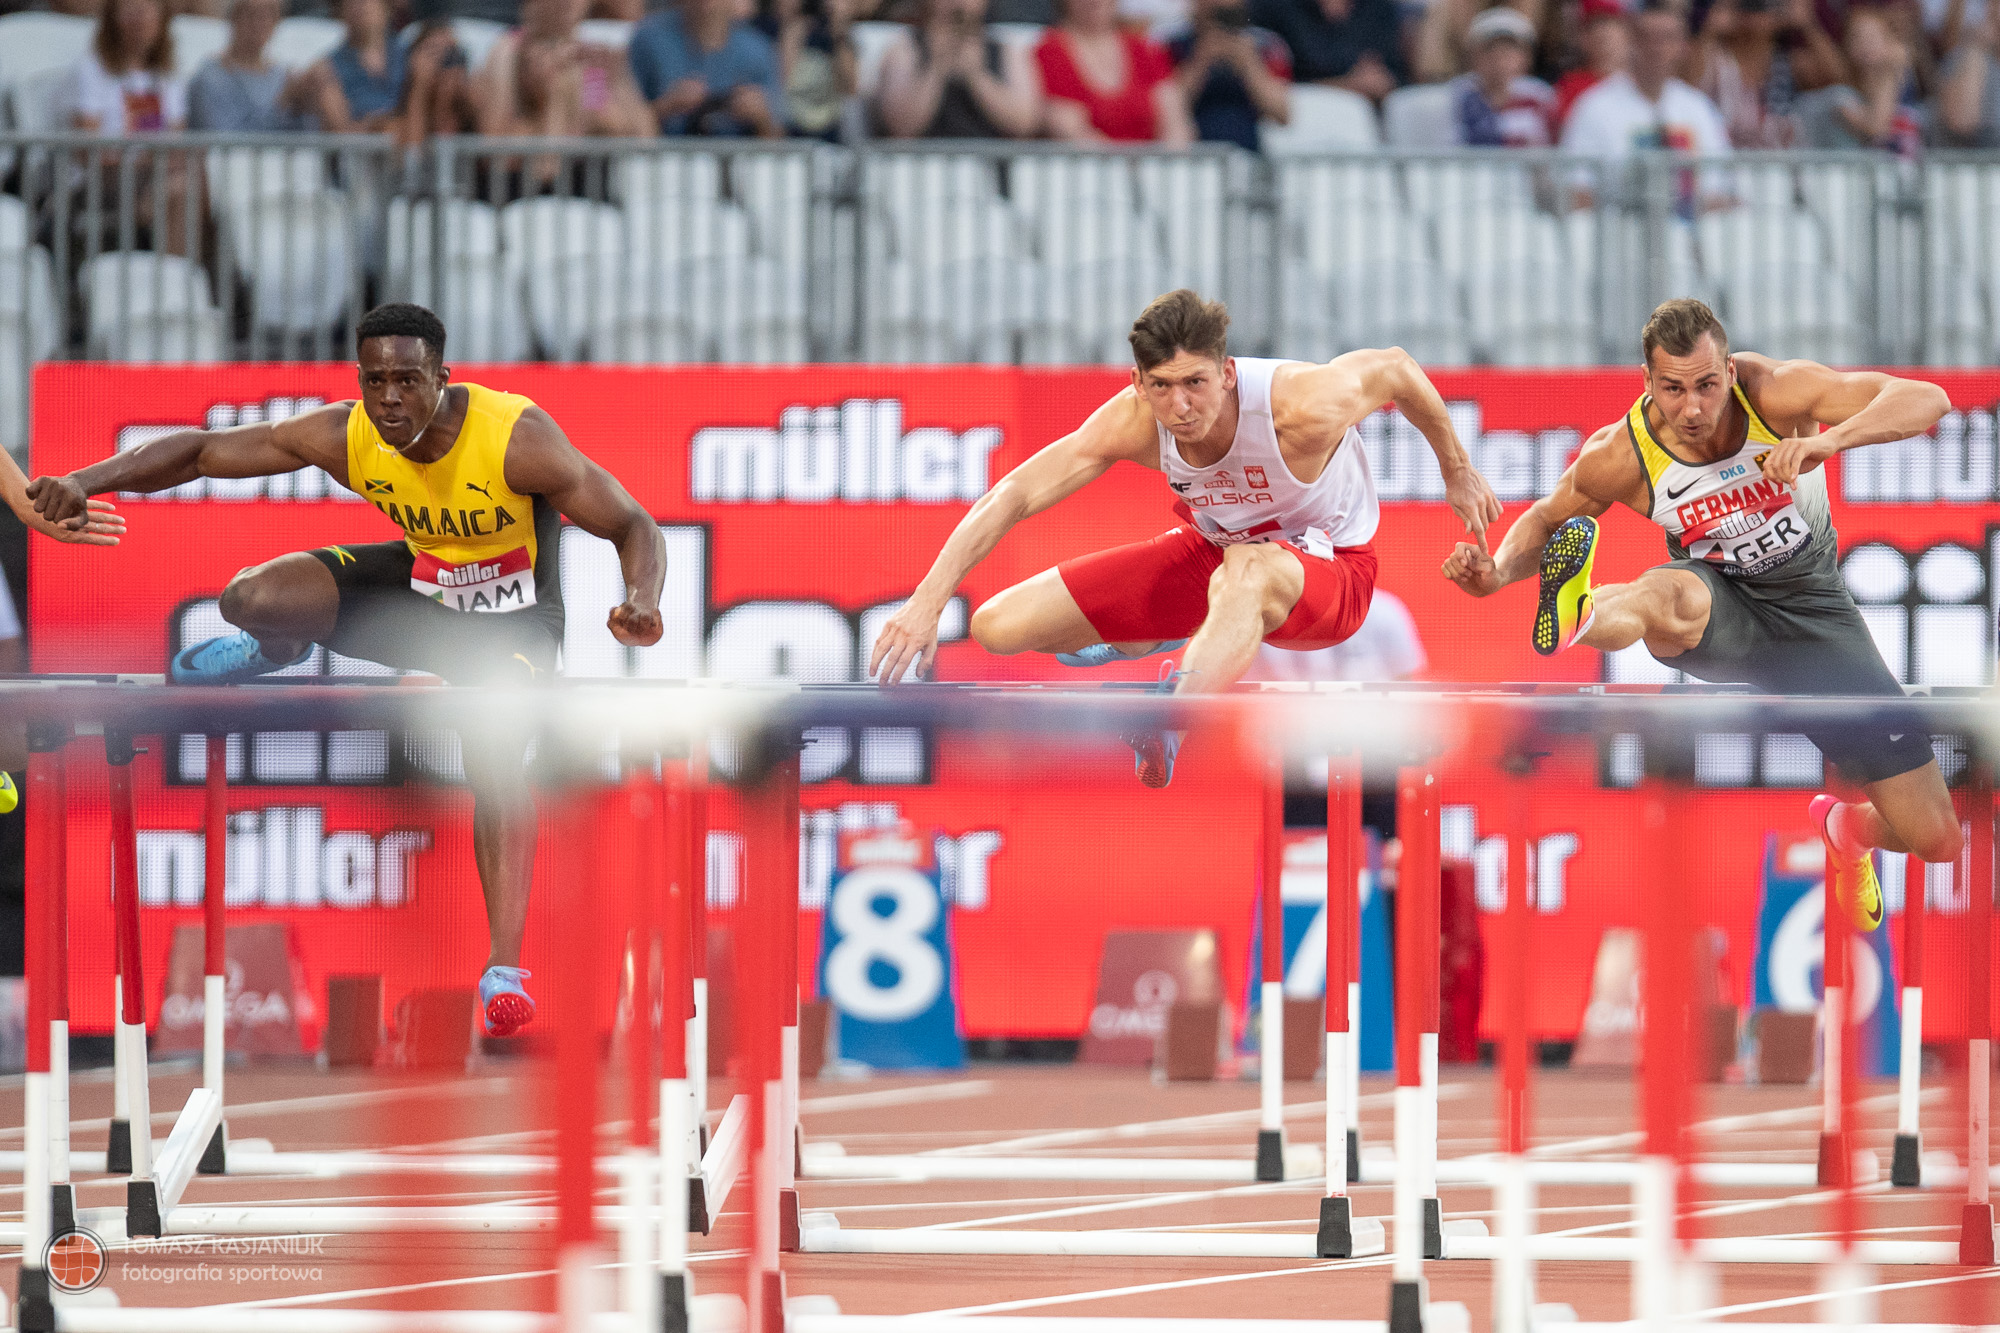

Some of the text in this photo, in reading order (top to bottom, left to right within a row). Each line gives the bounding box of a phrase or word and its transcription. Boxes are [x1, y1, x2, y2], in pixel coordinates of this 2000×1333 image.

[691, 399, 1002, 502] müller
[1206, 480, 1232, 488] ORLEN
[1719, 464, 1746, 481] DKB
[1677, 479, 1785, 530] GERMANY
[1705, 510, 1766, 539] müller
[1733, 516, 1801, 563] GER
[1763, 550, 1794, 566] WORLD
[436, 562, 502, 587] müller
[825, 864, 944, 1020] 8
